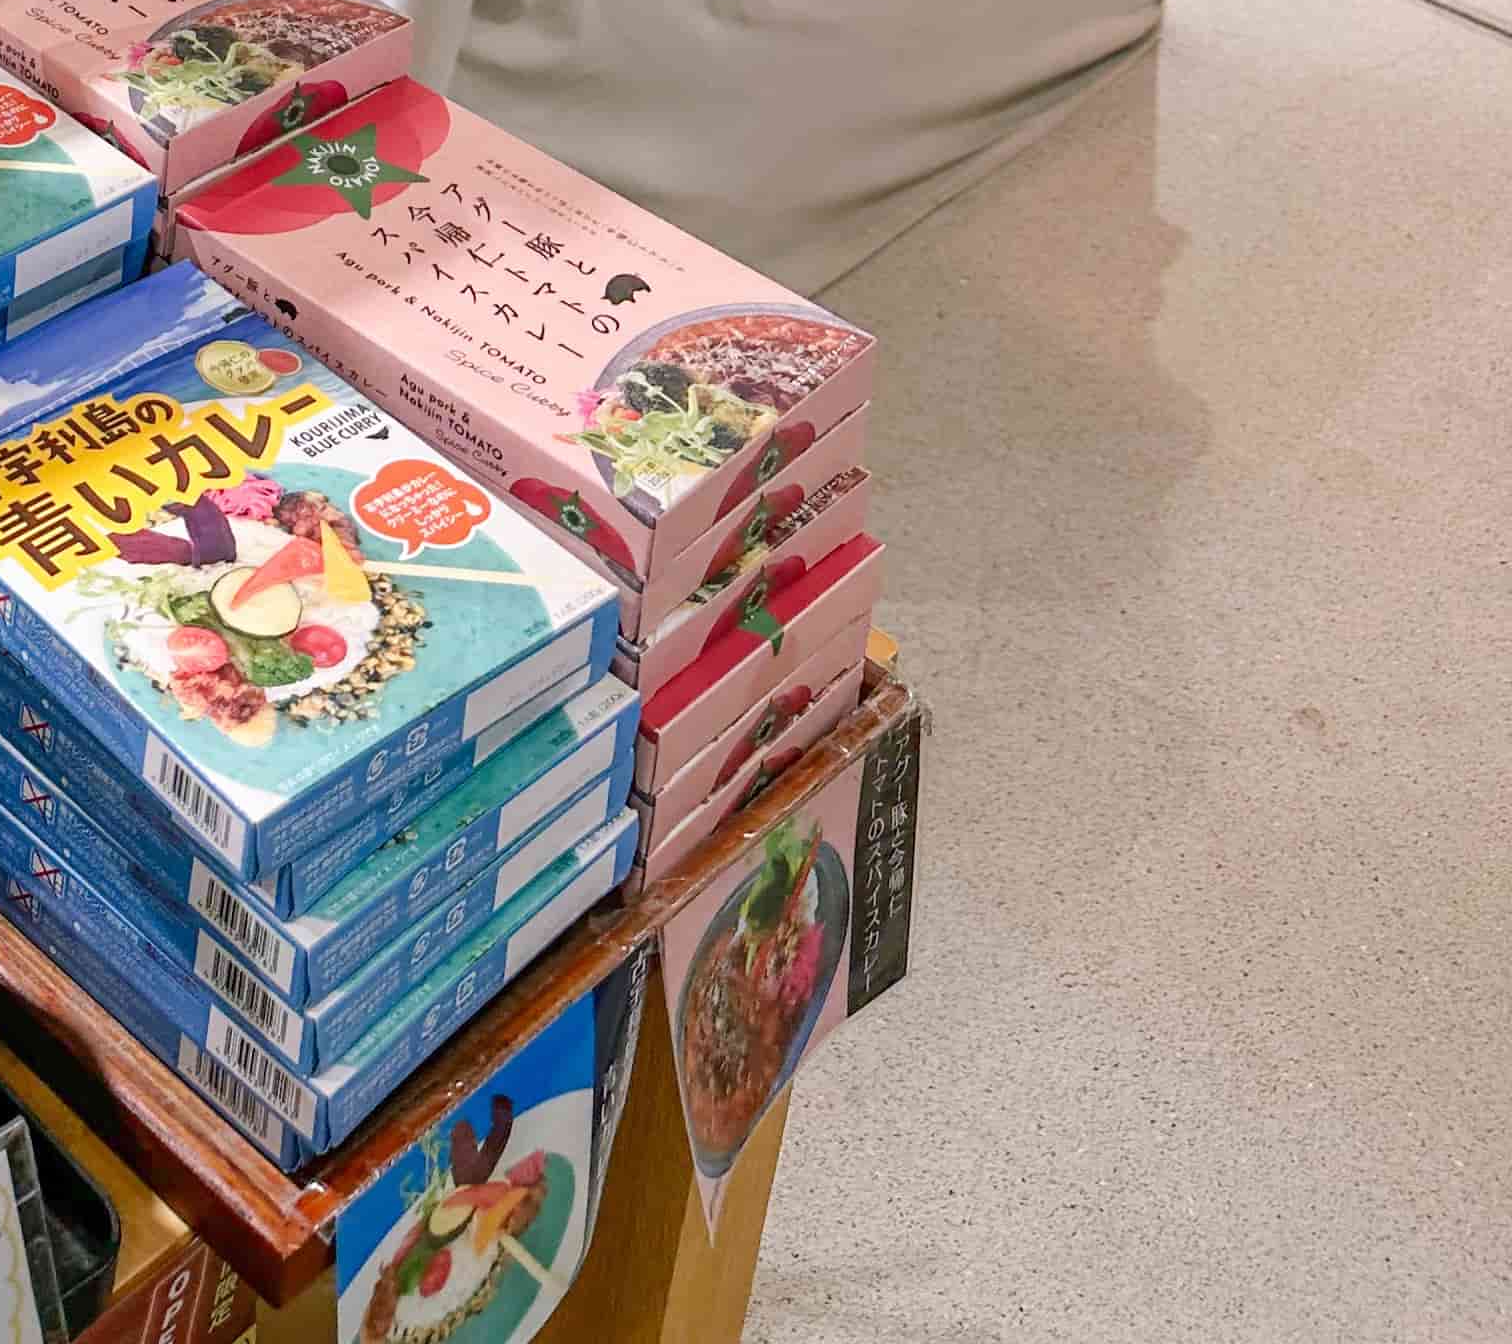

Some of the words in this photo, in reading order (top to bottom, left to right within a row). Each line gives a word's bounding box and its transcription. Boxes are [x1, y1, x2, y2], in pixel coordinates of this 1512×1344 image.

[57, 0, 110, 36] TOMATO
[19, 63, 61, 99] TOMATO
[306, 142, 357, 174] NAKIJIN
[329, 156, 381, 189] TOMATO
[440, 182, 597, 277] アグー豚と
[371, 226, 585, 360] スパイスカレー
[407, 203, 621, 337] 今帰仁トマトの
[335, 251, 364, 274] Agu
[365, 270, 402, 296] pork
[404, 294, 418, 306] &
[420, 304, 475, 343] Nakijin
[479, 341, 548, 386] TOMATO
[399, 372, 426, 394] Agu
[427, 390, 459, 415] pork
[442, 348, 504, 387] Spice
[509, 382, 572, 418] Curry
[289, 402, 370, 449] KOURIJIMA
[303, 429, 339, 460] BLUE
[338, 410, 384, 441] CURRY
[398, 389, 444, 426] Nakijin
[447, 417, 504, 463] TOMATO
[862, 754, 887, 994] トマトのスパイスカレー
